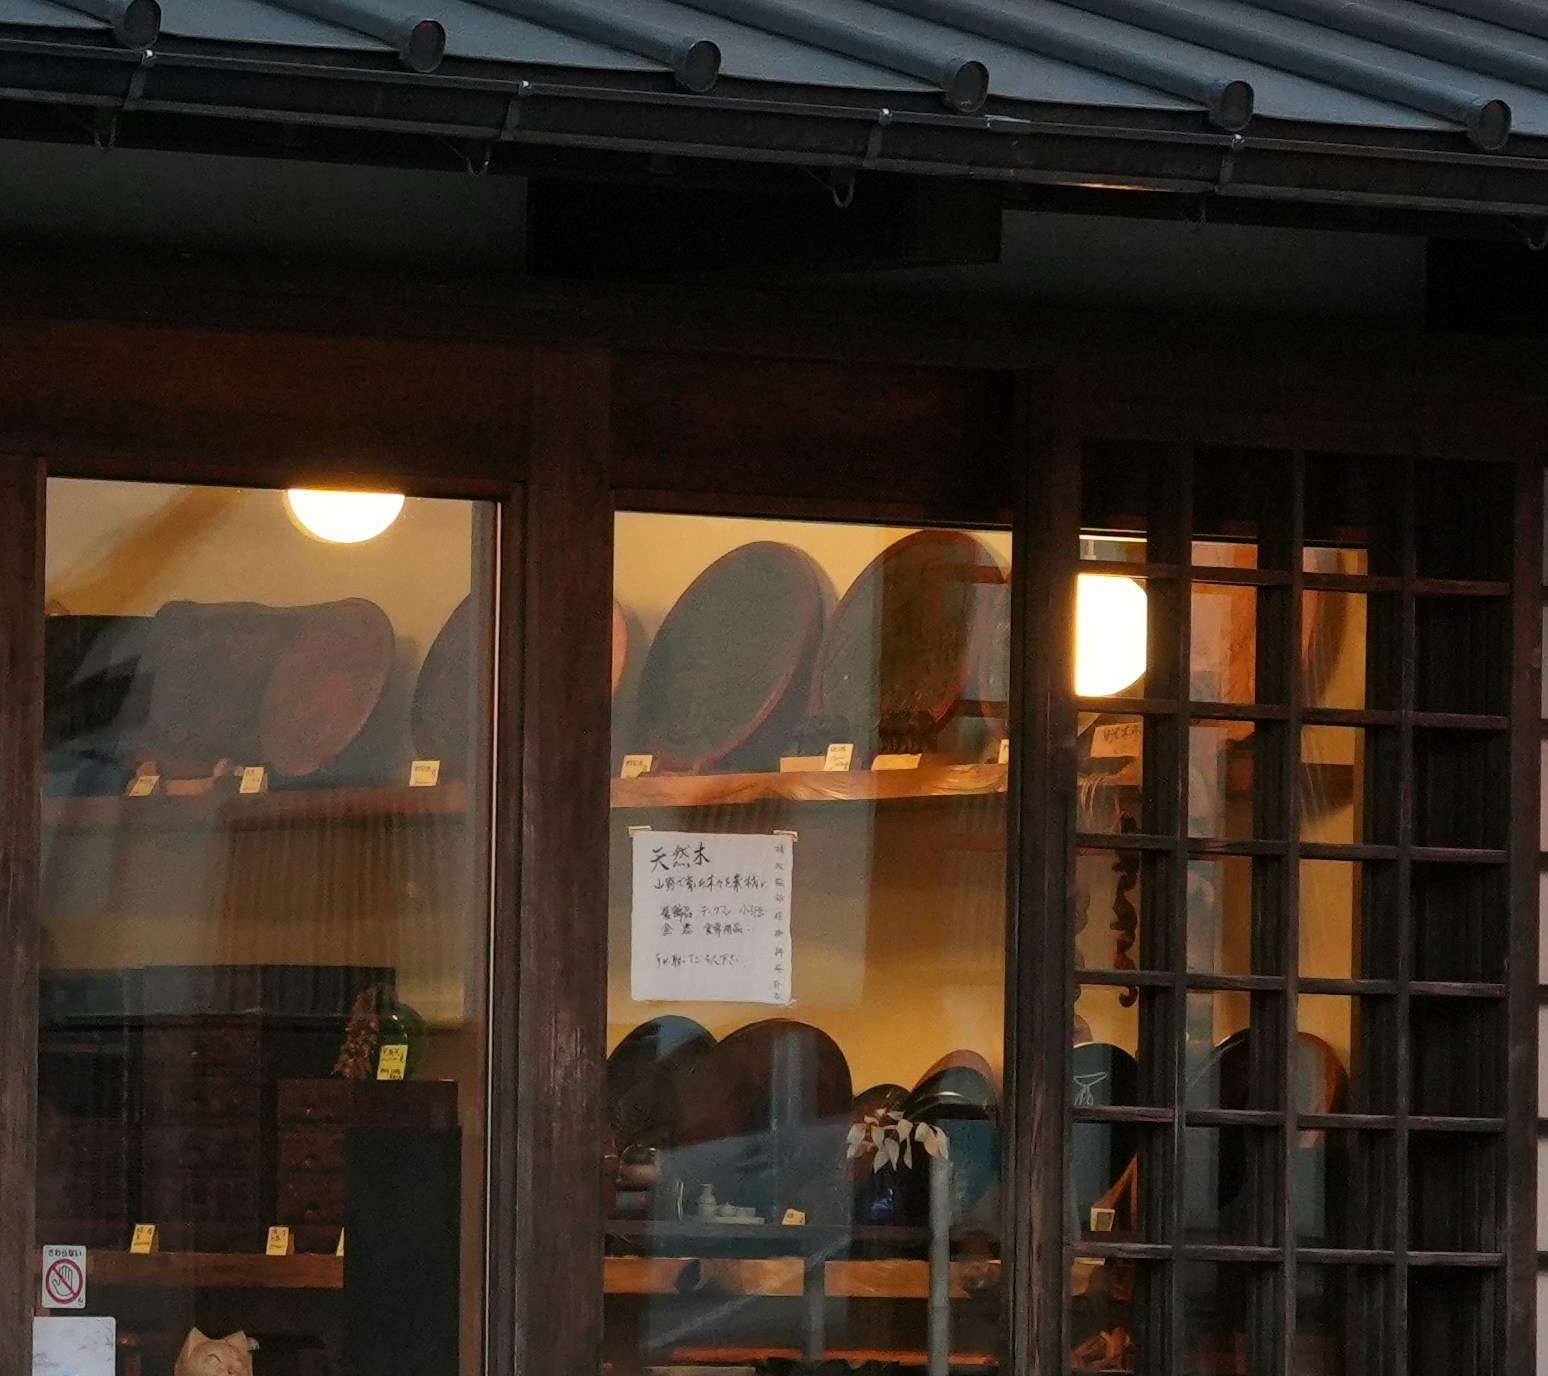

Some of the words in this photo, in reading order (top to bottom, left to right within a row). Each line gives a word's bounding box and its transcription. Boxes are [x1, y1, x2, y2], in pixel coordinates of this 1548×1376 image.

[651, 842, 711, 872] 天然木
[48, 1248, 82, 1257] さわらない
